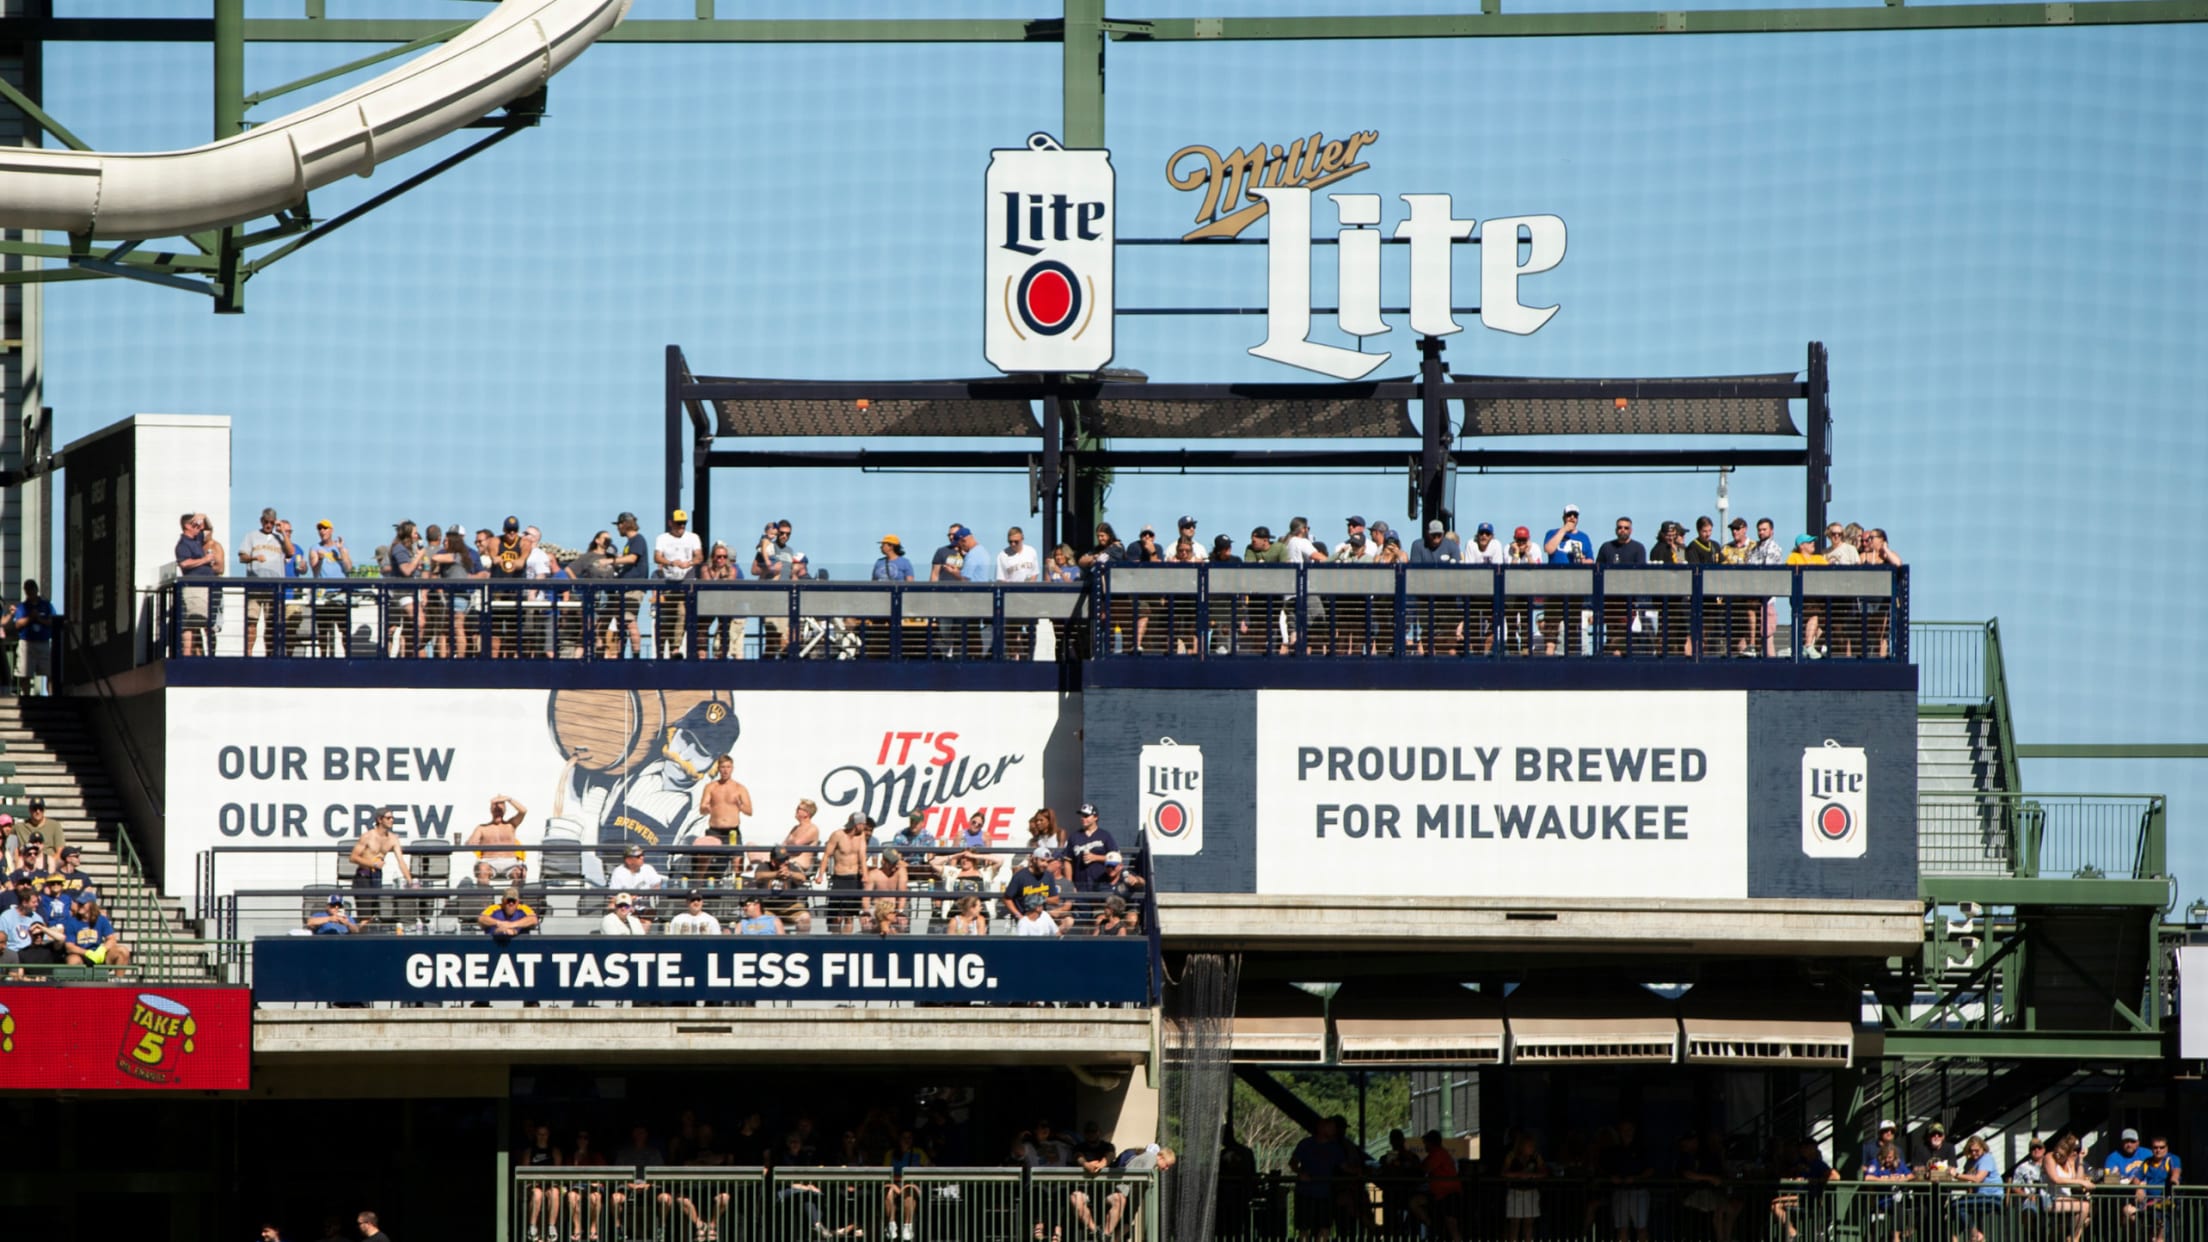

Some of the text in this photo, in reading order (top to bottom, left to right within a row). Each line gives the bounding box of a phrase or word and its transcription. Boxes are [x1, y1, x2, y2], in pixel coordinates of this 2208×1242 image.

[1167, 130, 1378, 240] Miller
[1000, 192, 1105, 255] Lite
[1248, 187, 1567, 379] Lite
[219, 746, 455, 781] OUR BREW
[877, 731, 959, 766] IT'S
[1299, 747, 1707, 782] PROUDLY BREWED
[821, 754, 1024, 828] Miller
[1147, 766, 1199, 797] Lite
[1810, 768, 1863, 799] Lite
[219, 803, 453, 838] OUR CREW
[1316, 804, 1688, 839] FOR MILWAUKEE
[406, 953, 997, 988] GREAT TASTE. LESS FILLING.
[133, 1004, 180, 1036] TAKE
[132, 1032, 163, 1063] 5
